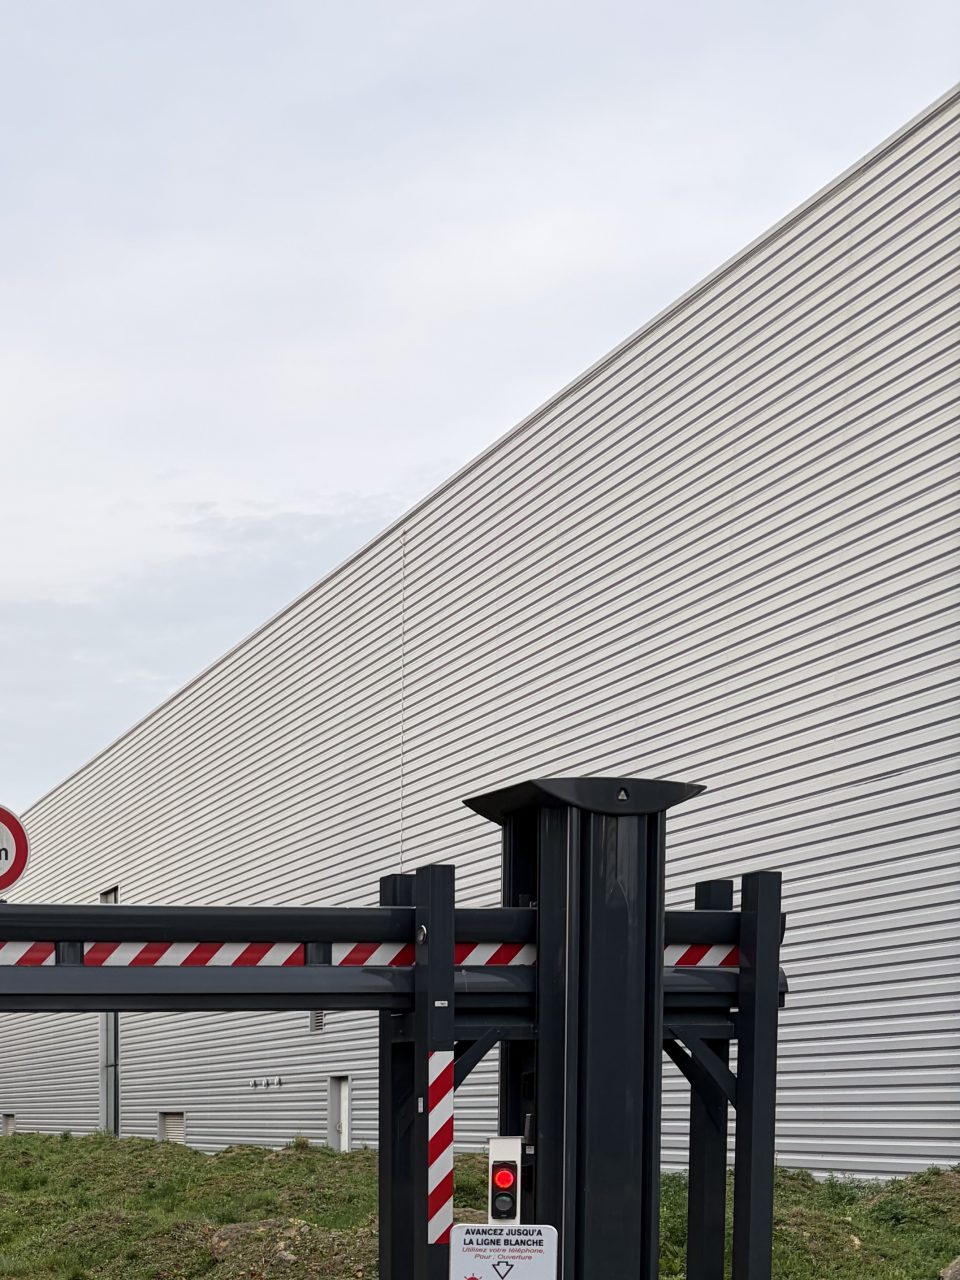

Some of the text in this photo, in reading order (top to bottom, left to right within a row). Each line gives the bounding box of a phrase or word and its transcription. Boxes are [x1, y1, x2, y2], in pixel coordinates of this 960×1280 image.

[464, 1228, 543, 1237] AVANCEZ JUSQU'A
[463, 1238, 544, 1247] LA LIGNE BLANCHE
